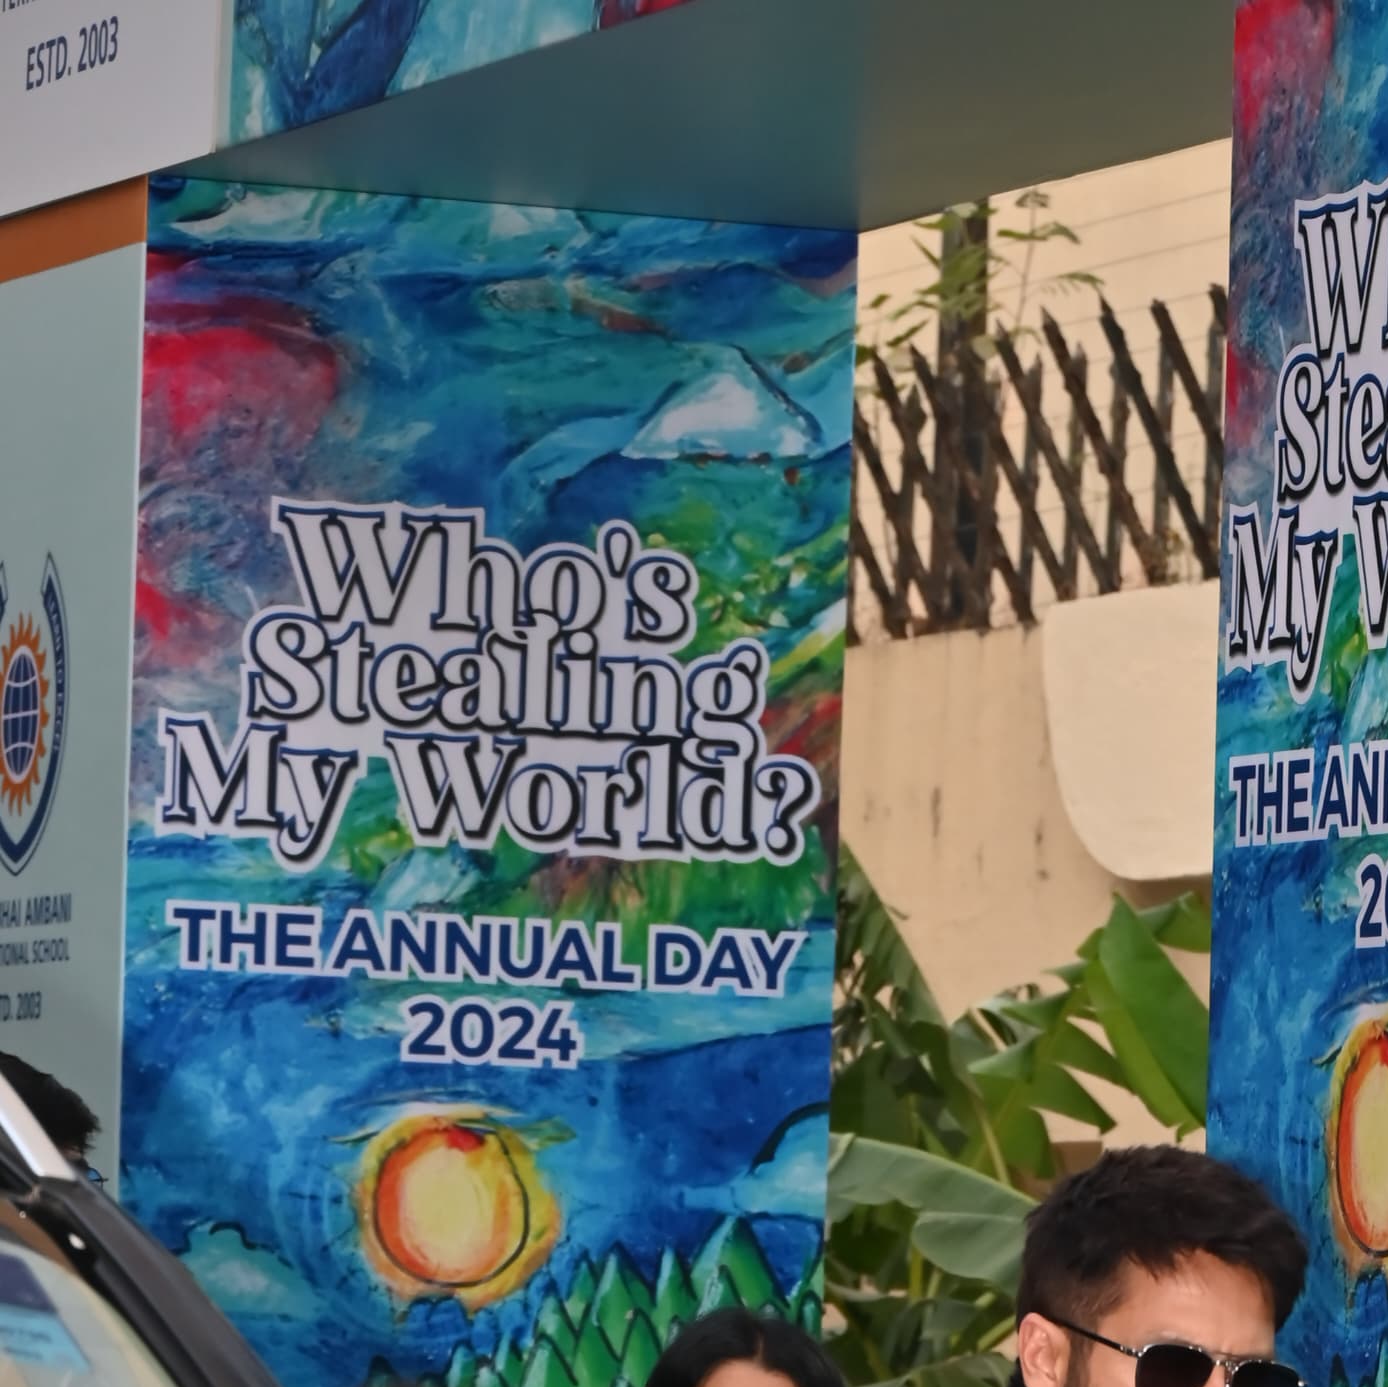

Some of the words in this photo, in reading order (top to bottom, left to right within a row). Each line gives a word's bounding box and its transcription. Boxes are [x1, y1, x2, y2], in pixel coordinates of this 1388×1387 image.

[26, 36, 72, 91] ESTD.
[77, 15, 119, 73] 2003
[277, 502, 692, 645] Who's
[1228, 506, 1340, 698] My
[247, 612, 763, 766] Stealing
[163, 718, 358, 862] My
[384, 730, 813, 859] World?
[1232, 760, 1311, 839] THE
[173, 908, 316, 968] THE
[332, 915, 637, 983] ANNUAL
[654, 926, 796, 990] DAY
[406, 1002, 578, 1062] 2024
